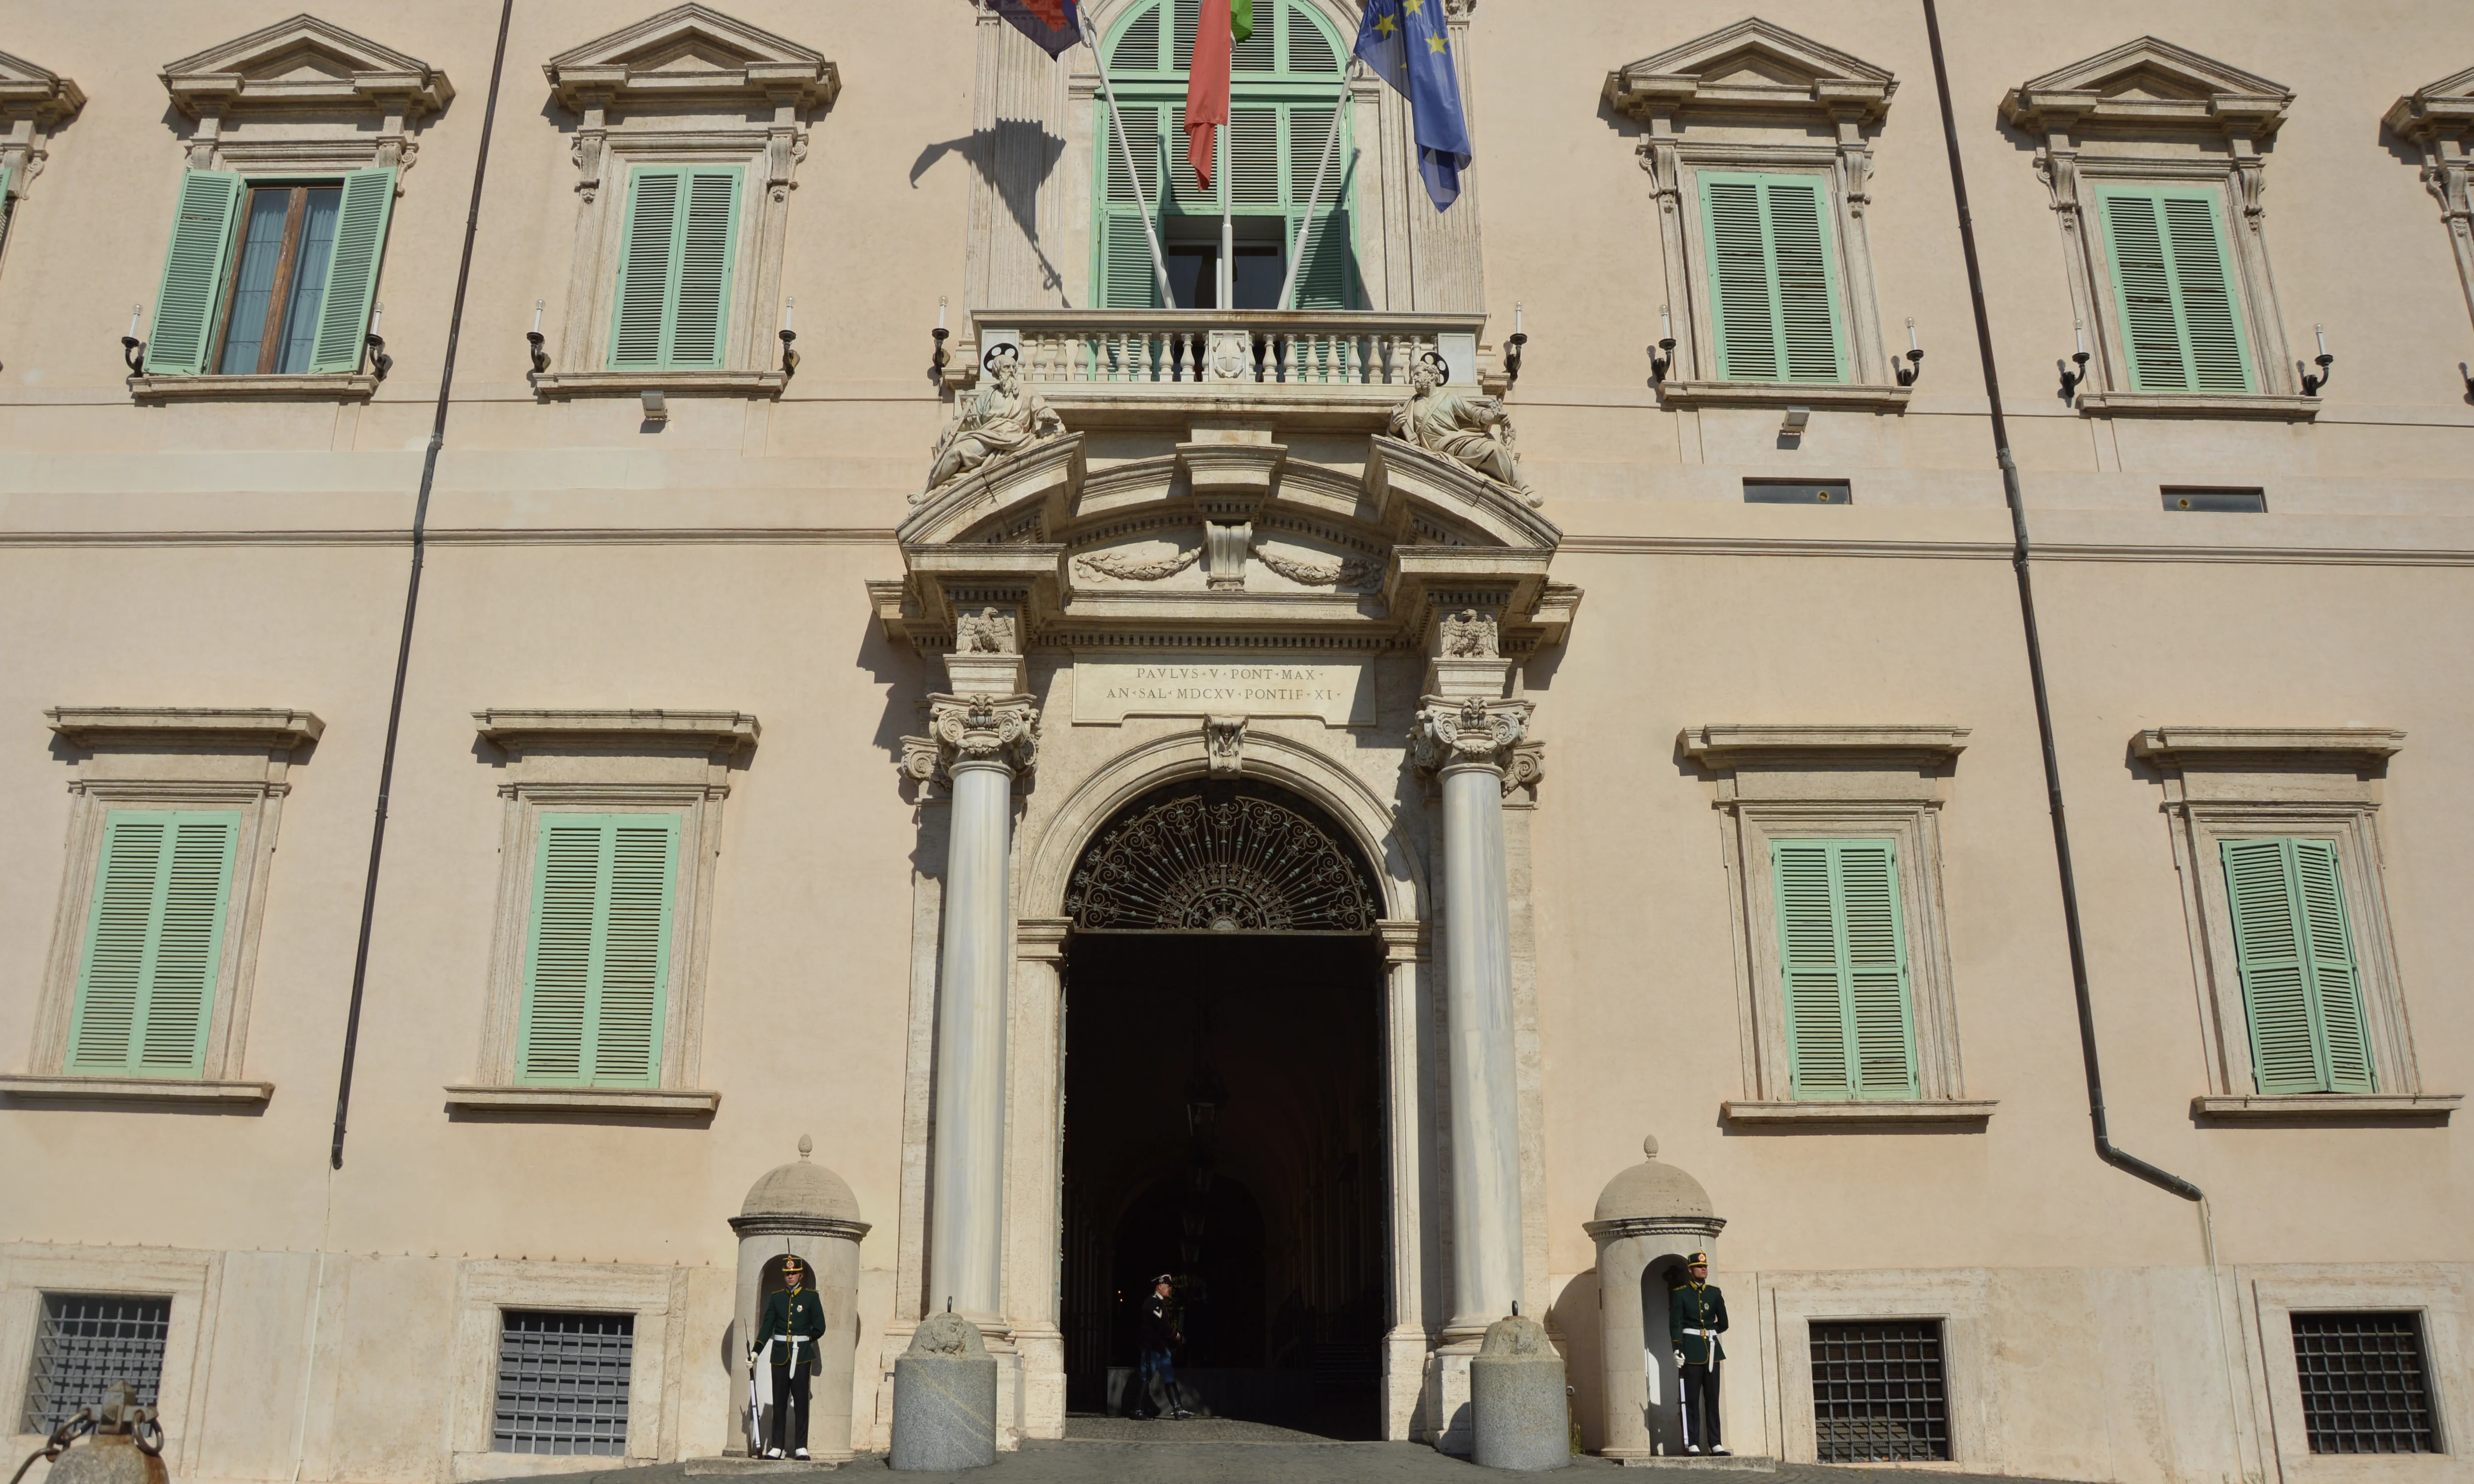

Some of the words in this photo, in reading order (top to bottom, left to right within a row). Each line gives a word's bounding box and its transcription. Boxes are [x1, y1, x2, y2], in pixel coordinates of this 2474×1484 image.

[1136, 668, 1198, 679] PAVLVS
[1231, 669, 1273, 679] PONT
[1281, 669, 1316, 680] MAX
[1106, 688, 1129, 698] AN
[1139, 688, 1167, 698] SAL
[1176, 689, 1235, 698] MDCXV
[1244, 689, 1303, 699] PONTIF
[1315, 690, 1332, 700] XI
